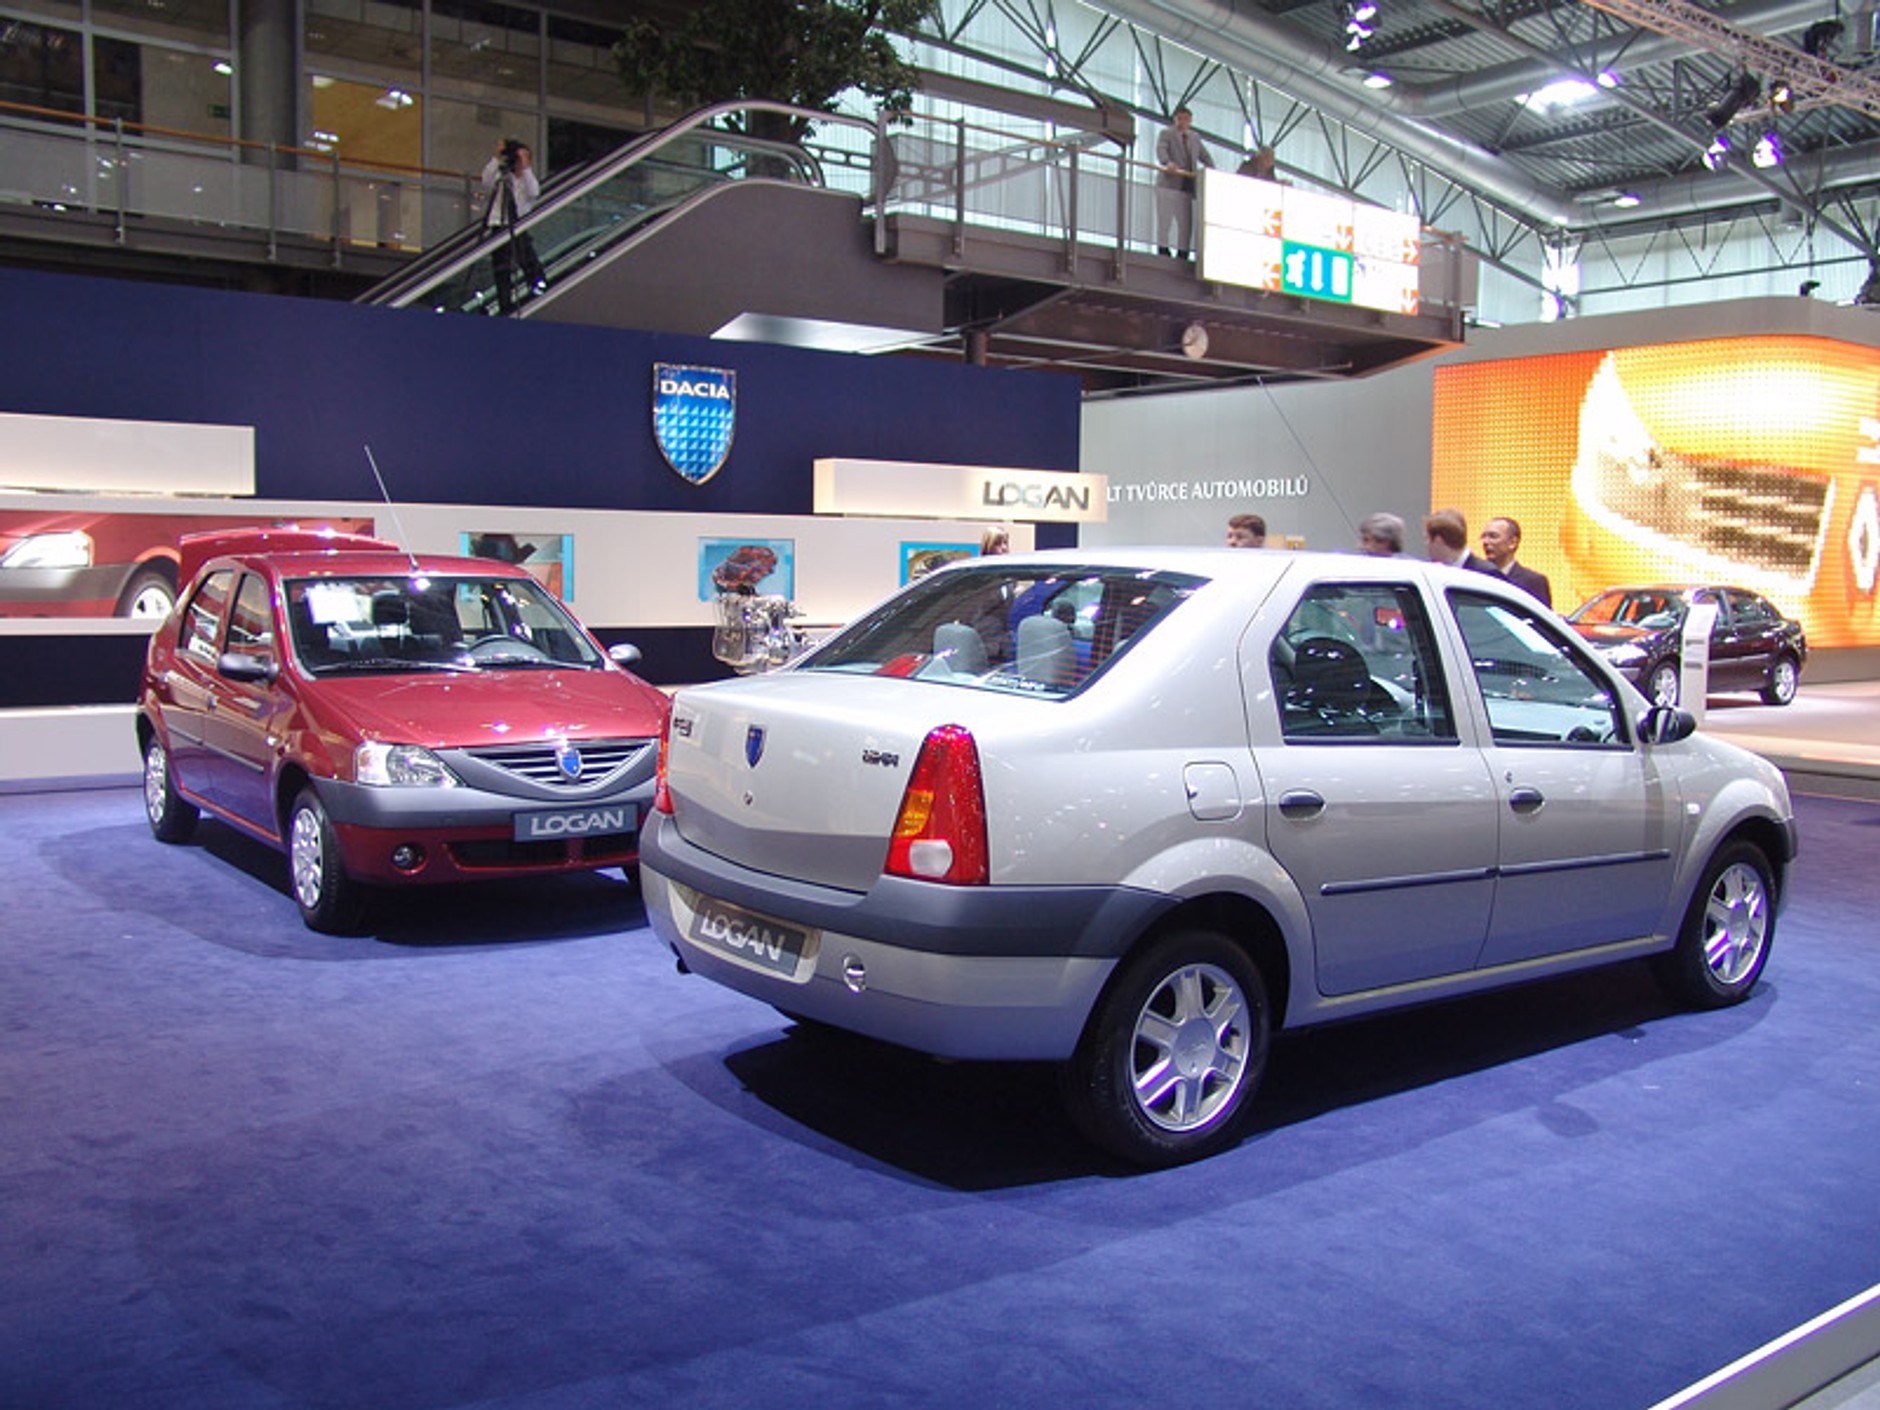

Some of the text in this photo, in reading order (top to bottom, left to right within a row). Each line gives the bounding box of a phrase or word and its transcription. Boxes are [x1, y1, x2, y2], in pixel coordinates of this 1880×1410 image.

[660, 379, 730, 399] DACIA
[982, 480, 1090, 510] LOGAN
[530, 809, 624, 836] LOGAN
[700, 909, 786, 962] LOGAN
